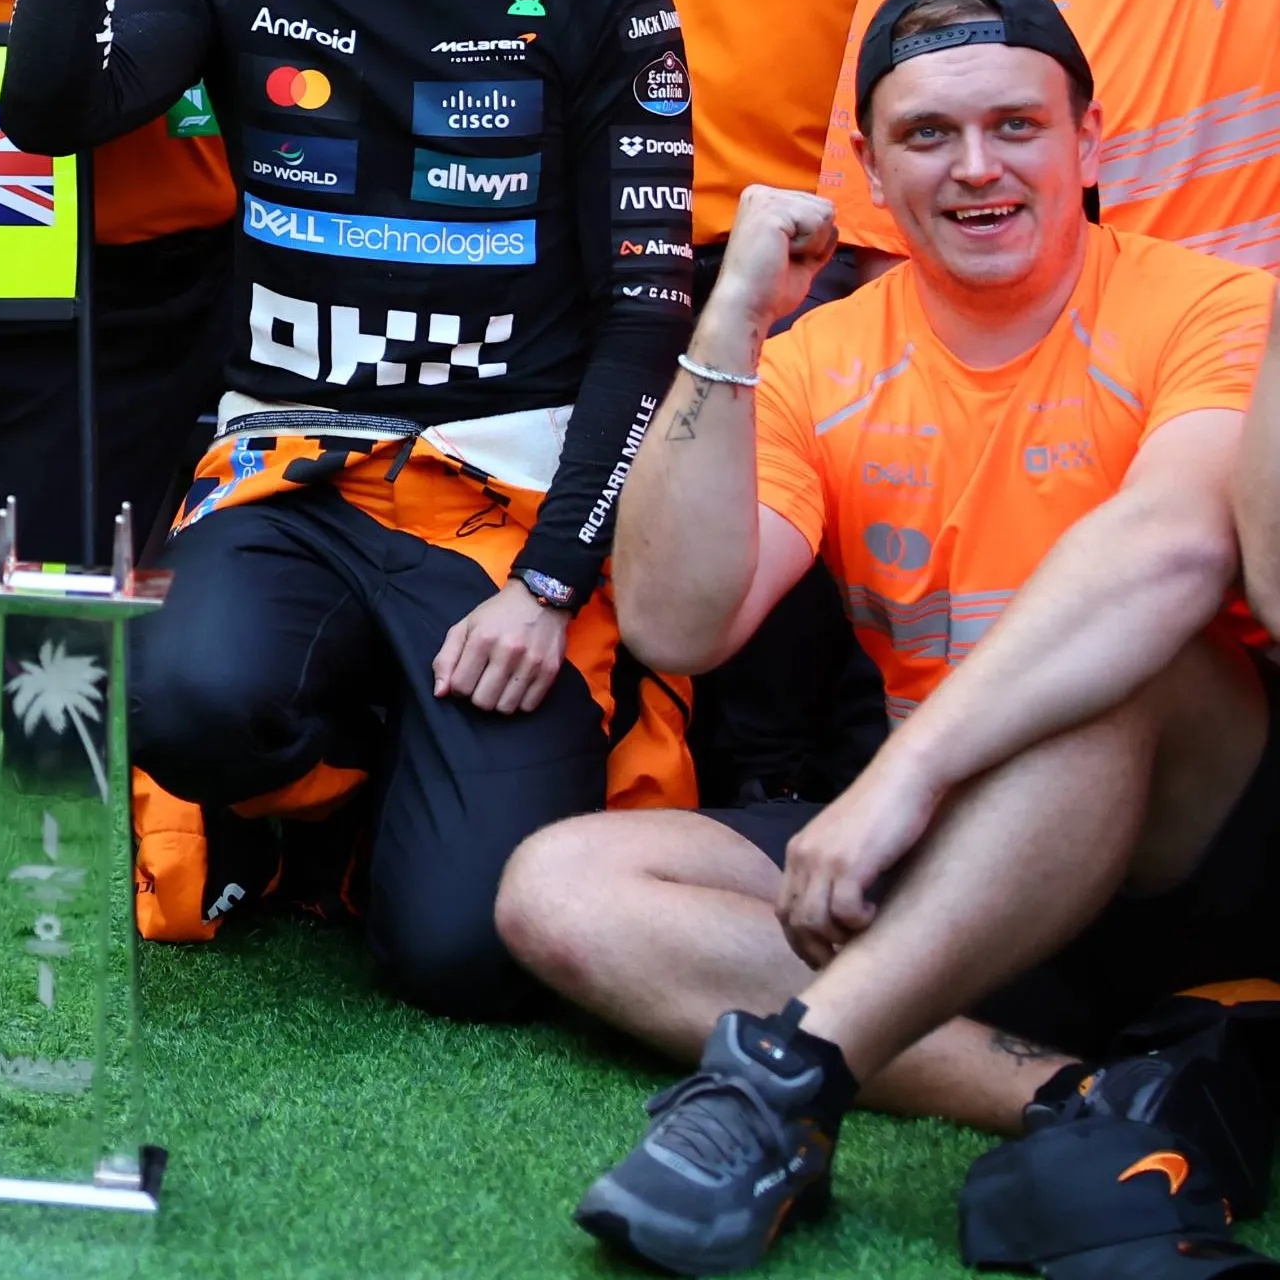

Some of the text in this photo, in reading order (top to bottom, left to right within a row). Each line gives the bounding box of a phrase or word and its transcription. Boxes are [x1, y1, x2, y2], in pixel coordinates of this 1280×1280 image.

[251, 7, 356, 55] Android
[628, 13, 660, 40] JACK
[431, 38, 525, 52] McLaren
[448, 113, 510, 129] CISCO
[646, 139, 694, 158] Dropbo
[253, 160, 338, 186] DP WORLD
[427, 163, 528, 201] allwyn
[250, 201, 524, 262] DELL Technologies
[249, 282, 514, 387] OKX
[579, 395, 658, 544] RICHARD MILLE
